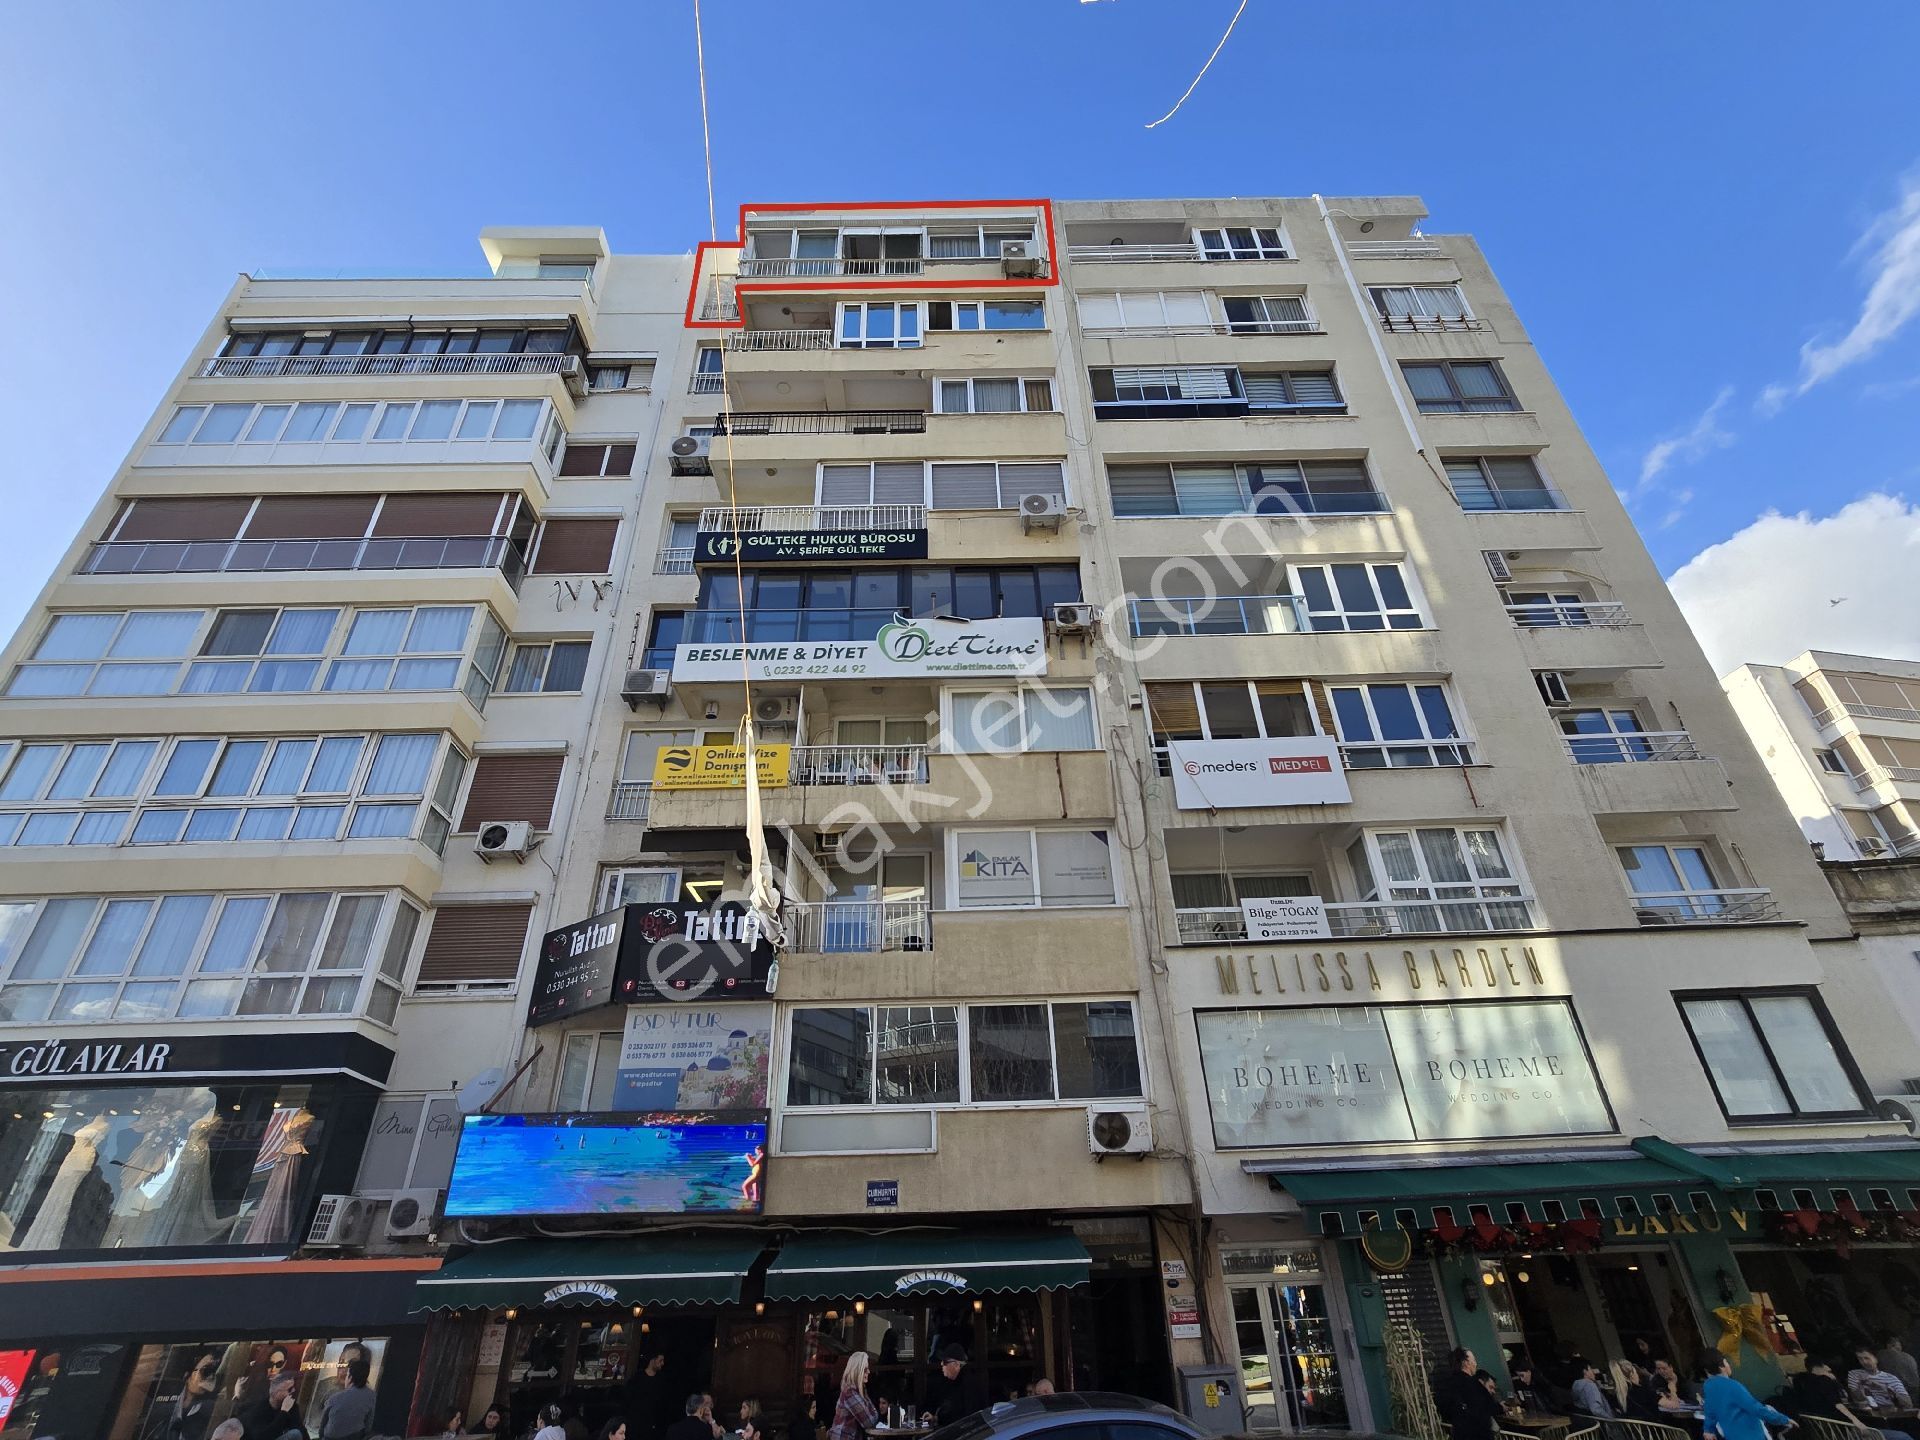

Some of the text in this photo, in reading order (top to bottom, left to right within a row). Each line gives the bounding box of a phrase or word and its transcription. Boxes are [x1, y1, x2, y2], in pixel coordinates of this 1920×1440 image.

[748, 532, 916, 546] GÜLTEKE HUKUK BÜROSU
[776, 544, 886, 556] AV. ŞERİFE GÜLTEKE
[686, 643, 868, 663] BESLENME & DİYET
[894, 634, 1037, 659] Diet Time
[774, 664, 866, 675] 0232 422 44 92
[706, 748, 746, 760] Online
[1202, 760, 1257, 773] meders
[977, 862, 1030, 877] KITA
[1249, 906, 1320, 919] Bilge TOGAY
[684, 909, 764, 942] Tatt
[569, 923, 617, 957] Tattoo
[1215, 951, 1382, 995] MELISSA
[632, 1011, 730, 1031] PSD TUR
[10, 1039, 170, 1075] GÜLAYLAR
[1233, 1063, 1371, 1088] BOHEME
[1426, 1055, 1565, 1081] BOHEME
[1251, 1098, 1325, 1111] WEDDING
[1448, 1090, 1520, 1103] WEDDING
[902, 1271, 960, 1286] KALYON
[552, 1281, 611, 1298] KALYON
